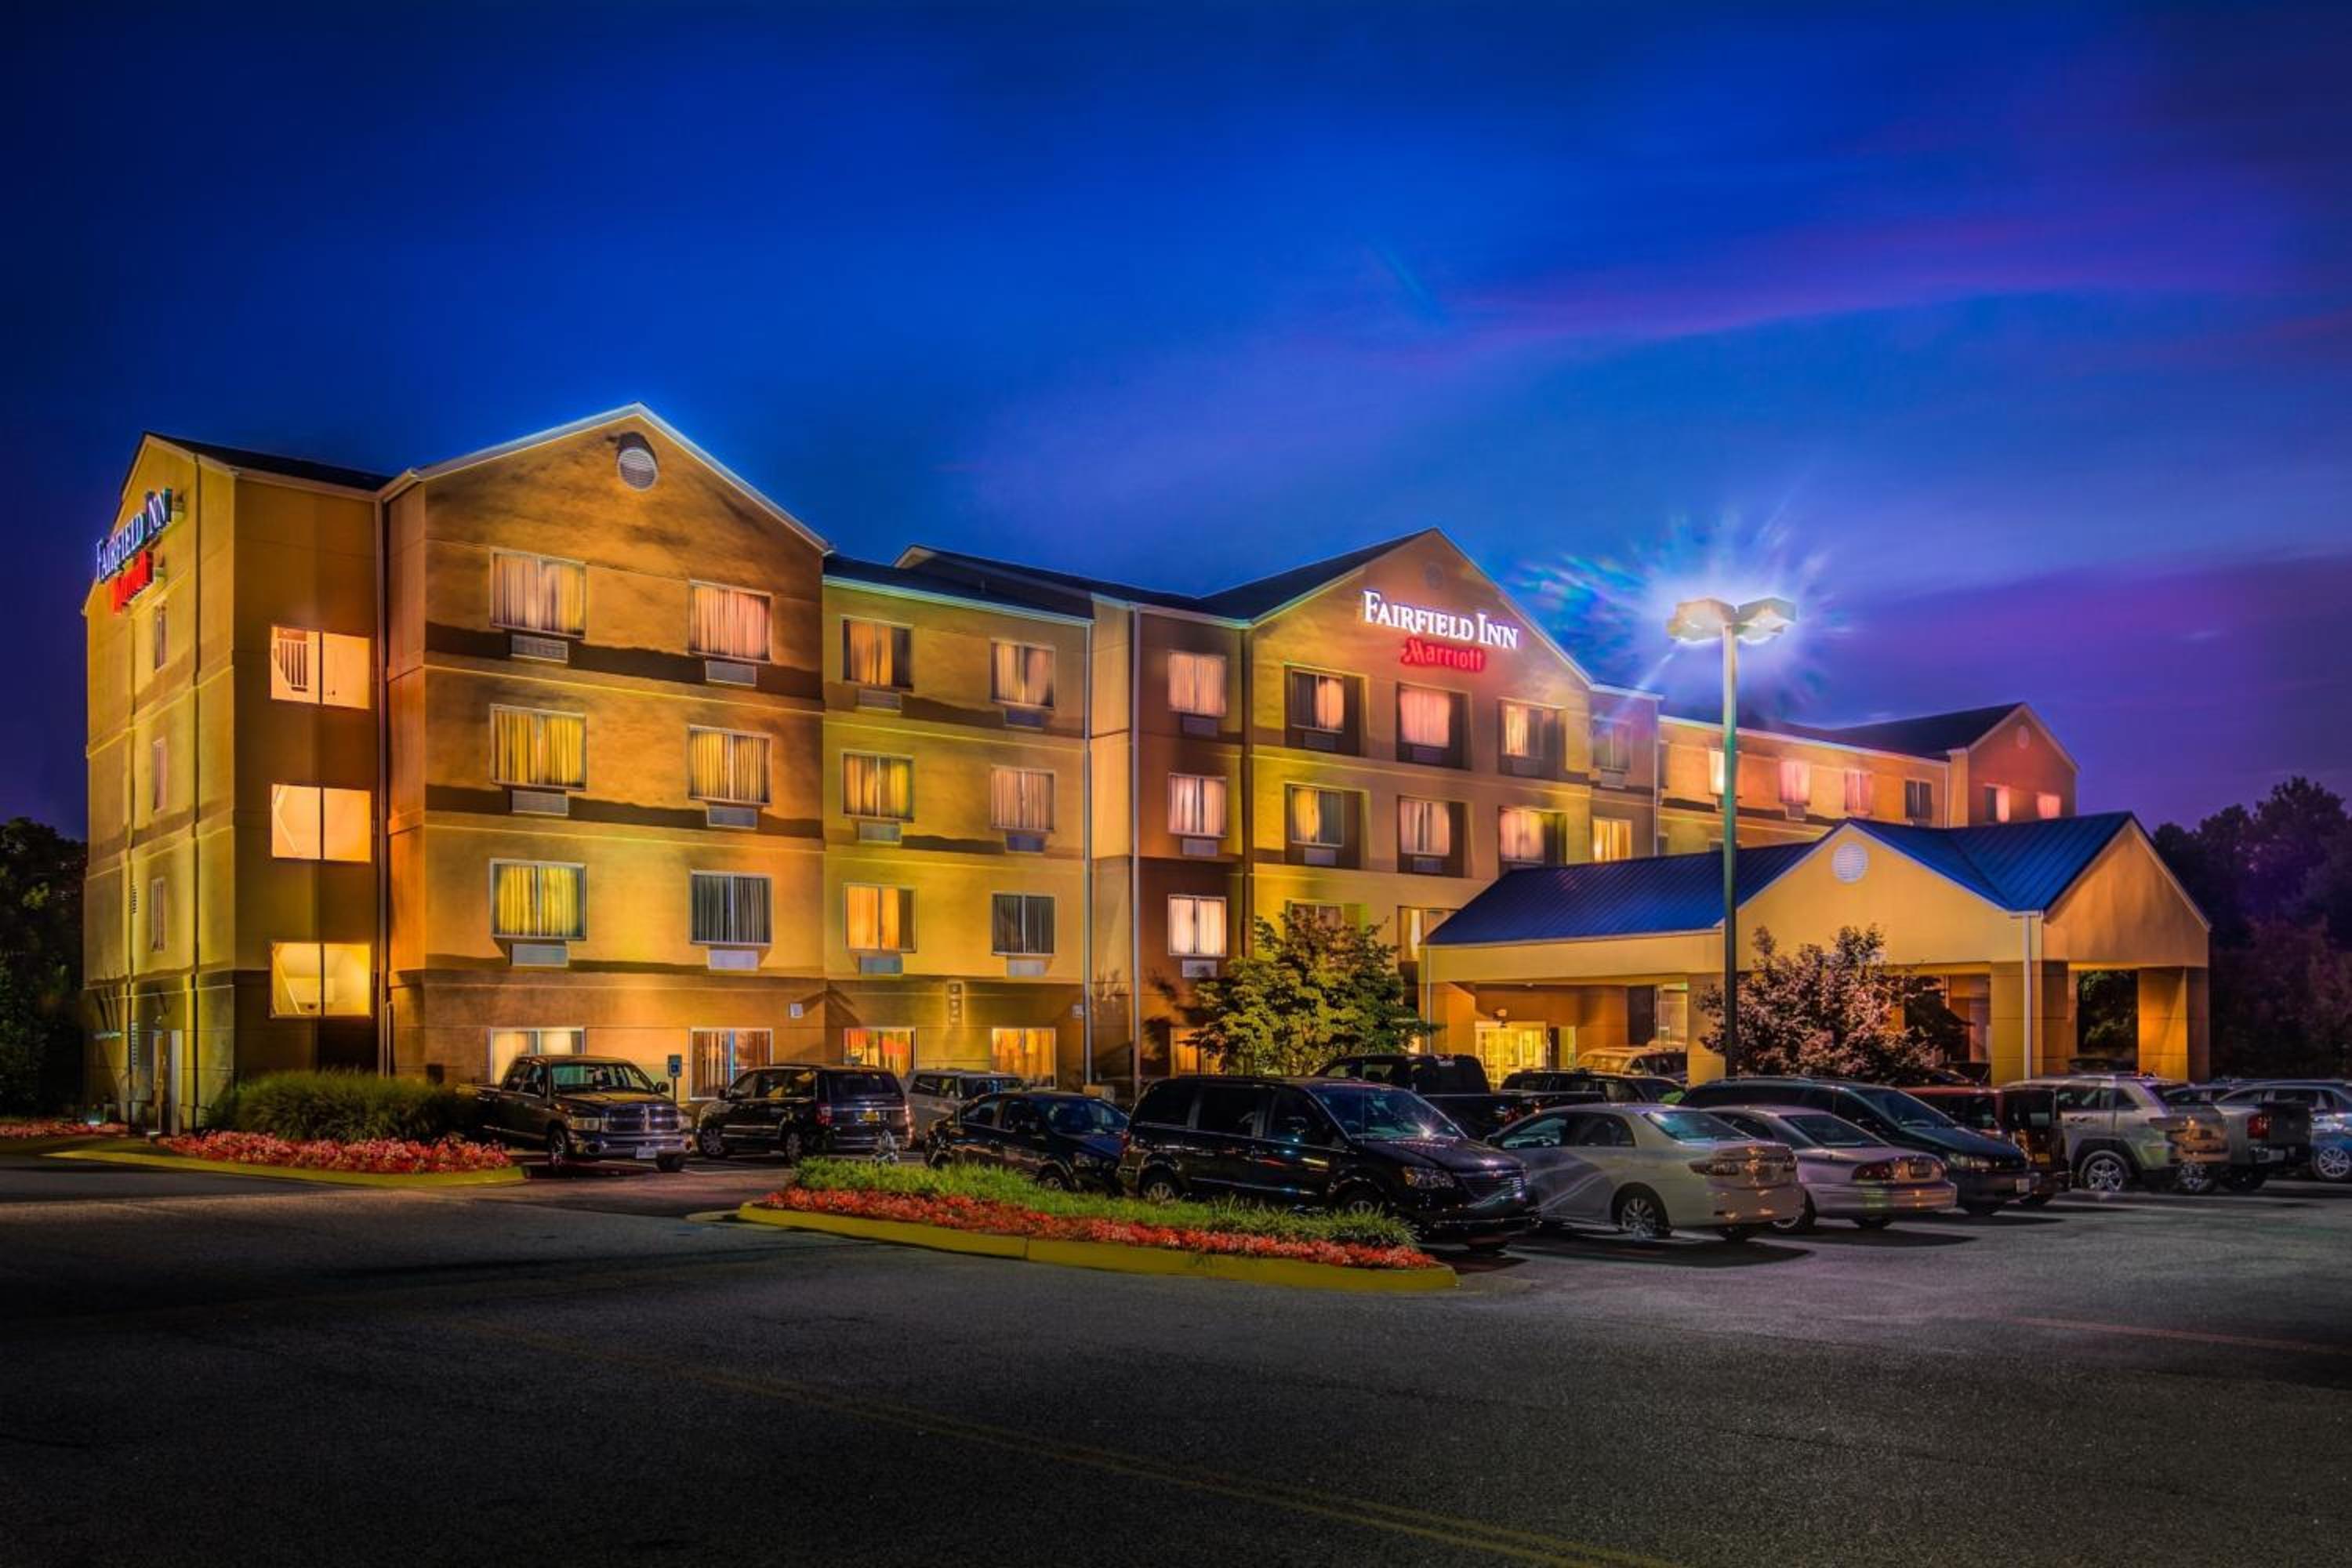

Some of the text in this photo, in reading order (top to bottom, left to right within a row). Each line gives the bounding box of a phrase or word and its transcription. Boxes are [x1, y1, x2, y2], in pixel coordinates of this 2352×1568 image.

[1363, 590, 1519, 649] FAIRFIELD INN
[1402, 639, 1483, 670] Marriott
